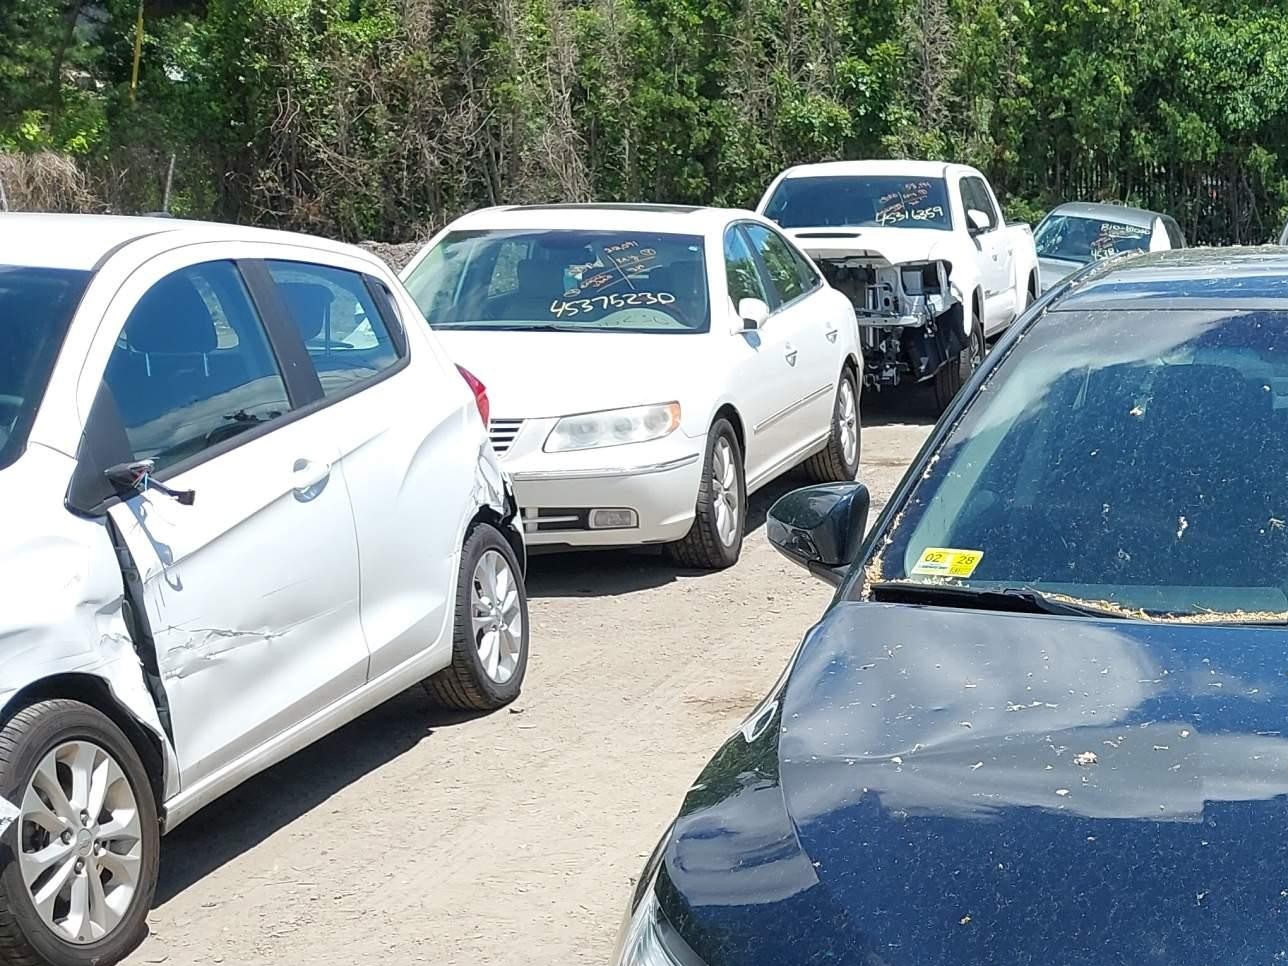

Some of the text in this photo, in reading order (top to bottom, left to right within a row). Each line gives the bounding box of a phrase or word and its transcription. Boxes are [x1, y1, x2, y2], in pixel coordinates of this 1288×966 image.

[875, 206, 944, 227] 45316359
[550, 292, 676, 317] 45375230
[924, 553, 975, 565] 02 28
